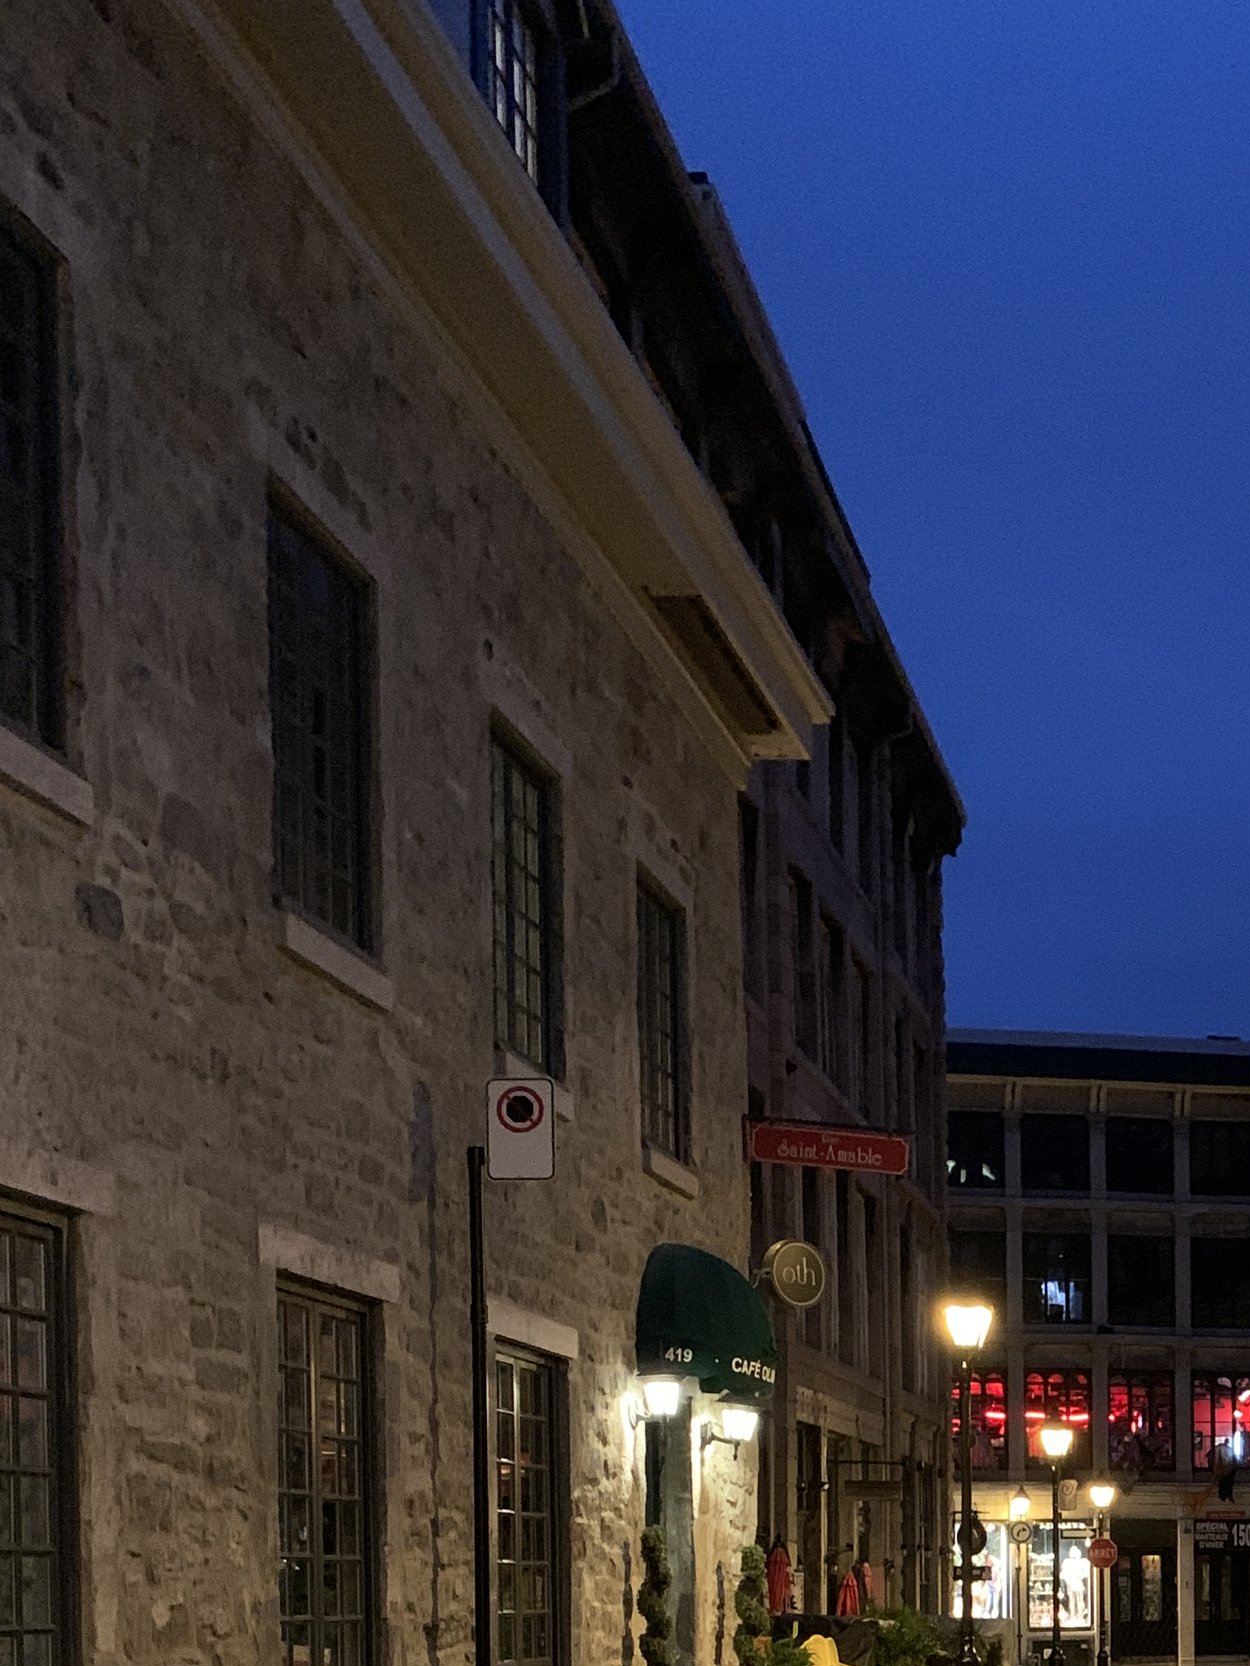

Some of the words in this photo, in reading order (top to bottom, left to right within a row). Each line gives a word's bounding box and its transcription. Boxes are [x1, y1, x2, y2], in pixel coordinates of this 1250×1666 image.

[777, 1139, 883, 1165] Saint-Amable
[782, 1257, 817, 1287] oth
[664, 1347, 693, 1363] 419
[731, 1357, 761, 1379] CAFÉ
